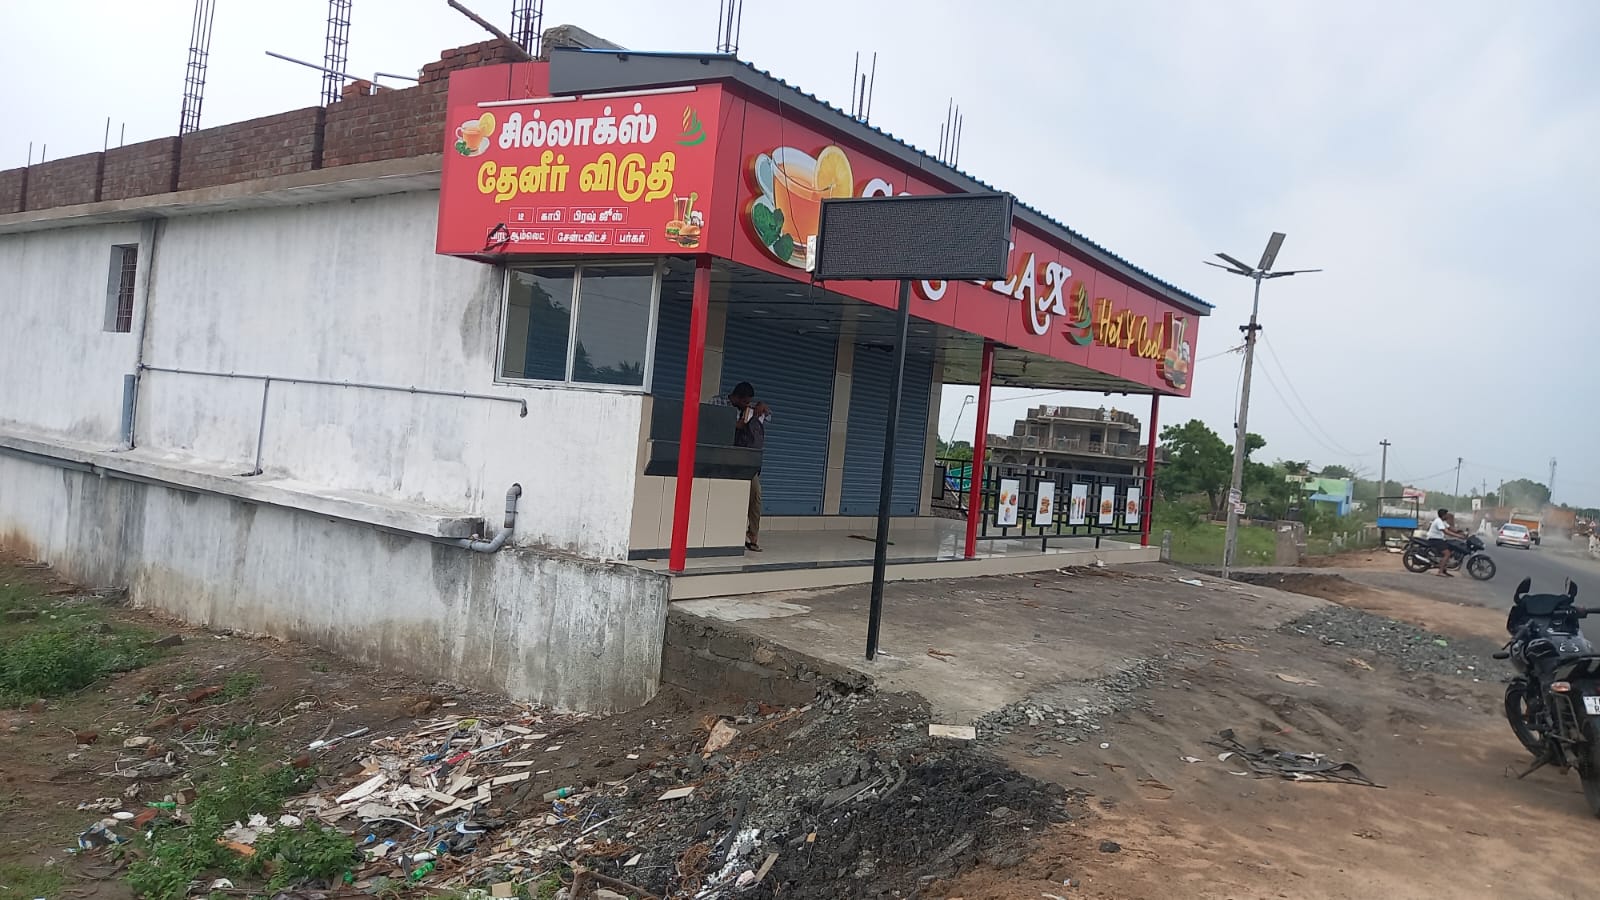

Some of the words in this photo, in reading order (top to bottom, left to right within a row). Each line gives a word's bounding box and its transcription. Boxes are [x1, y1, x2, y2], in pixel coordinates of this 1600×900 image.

[499, 102, 657, 149] சில்லாக்ஸ்
[477, 150, 570, 203] தேனீர்
[579, 151, 676, 202] விடுதி
[540, 210, 561, 221] காபி
[619, 232, 646, 243] பர்கர்
[1099, 298, 1123, 348] Hot
[1137, 315, 1165, 360] Cool
